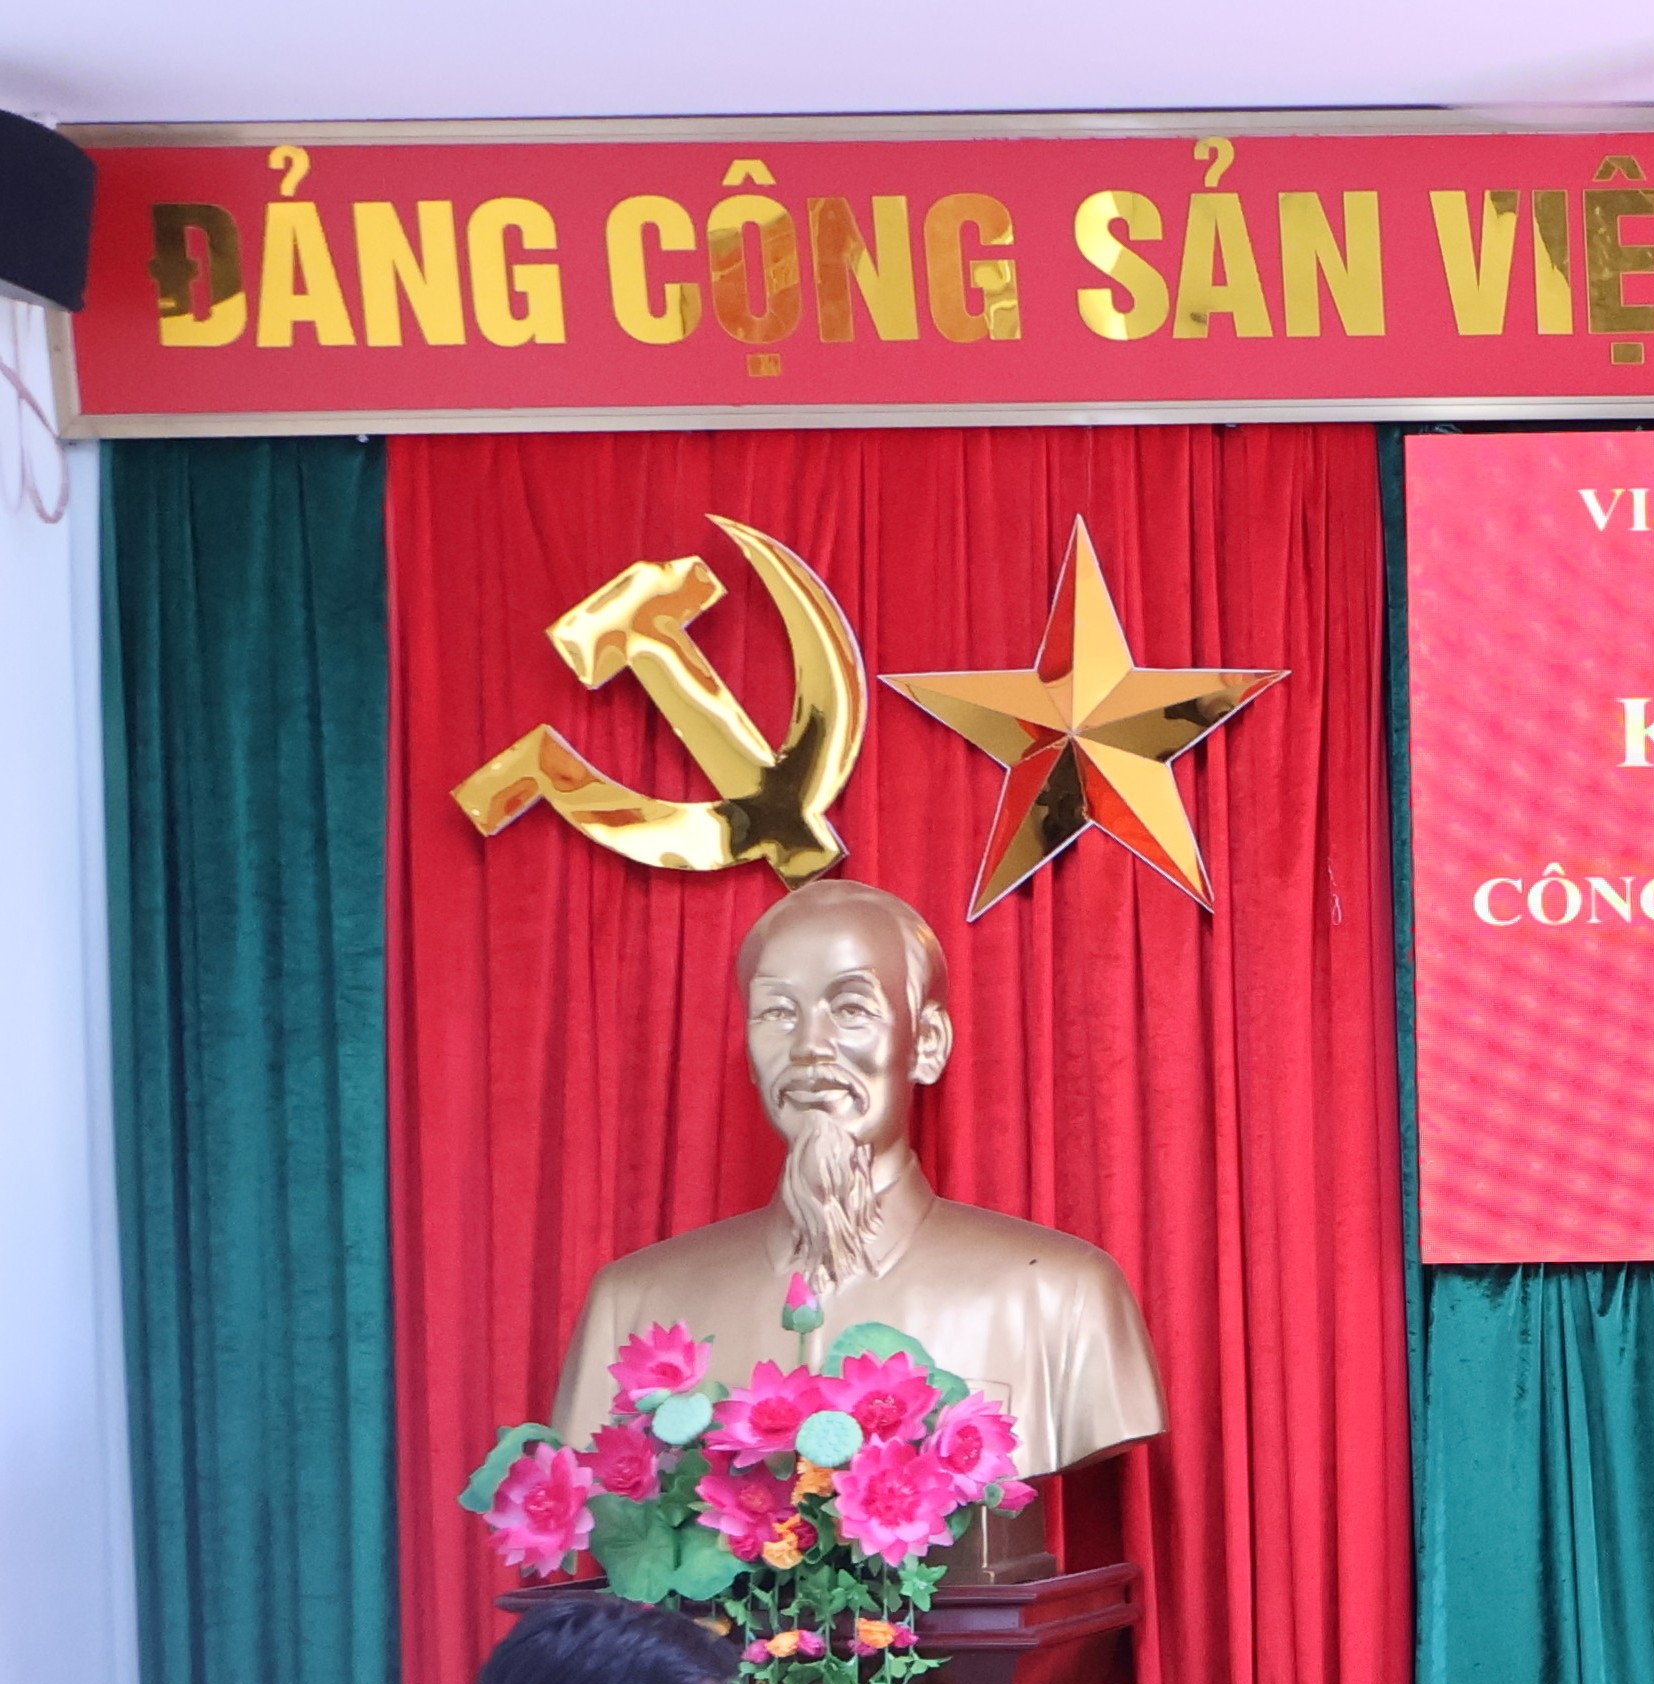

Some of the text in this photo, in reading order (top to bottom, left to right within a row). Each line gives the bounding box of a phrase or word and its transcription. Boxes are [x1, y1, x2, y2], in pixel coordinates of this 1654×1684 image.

[147, 144, 567, 348] ĐẢNG
[606, 158, 1023, 378] CỘNG
[1073, 135, 1385, 342] SẢN
